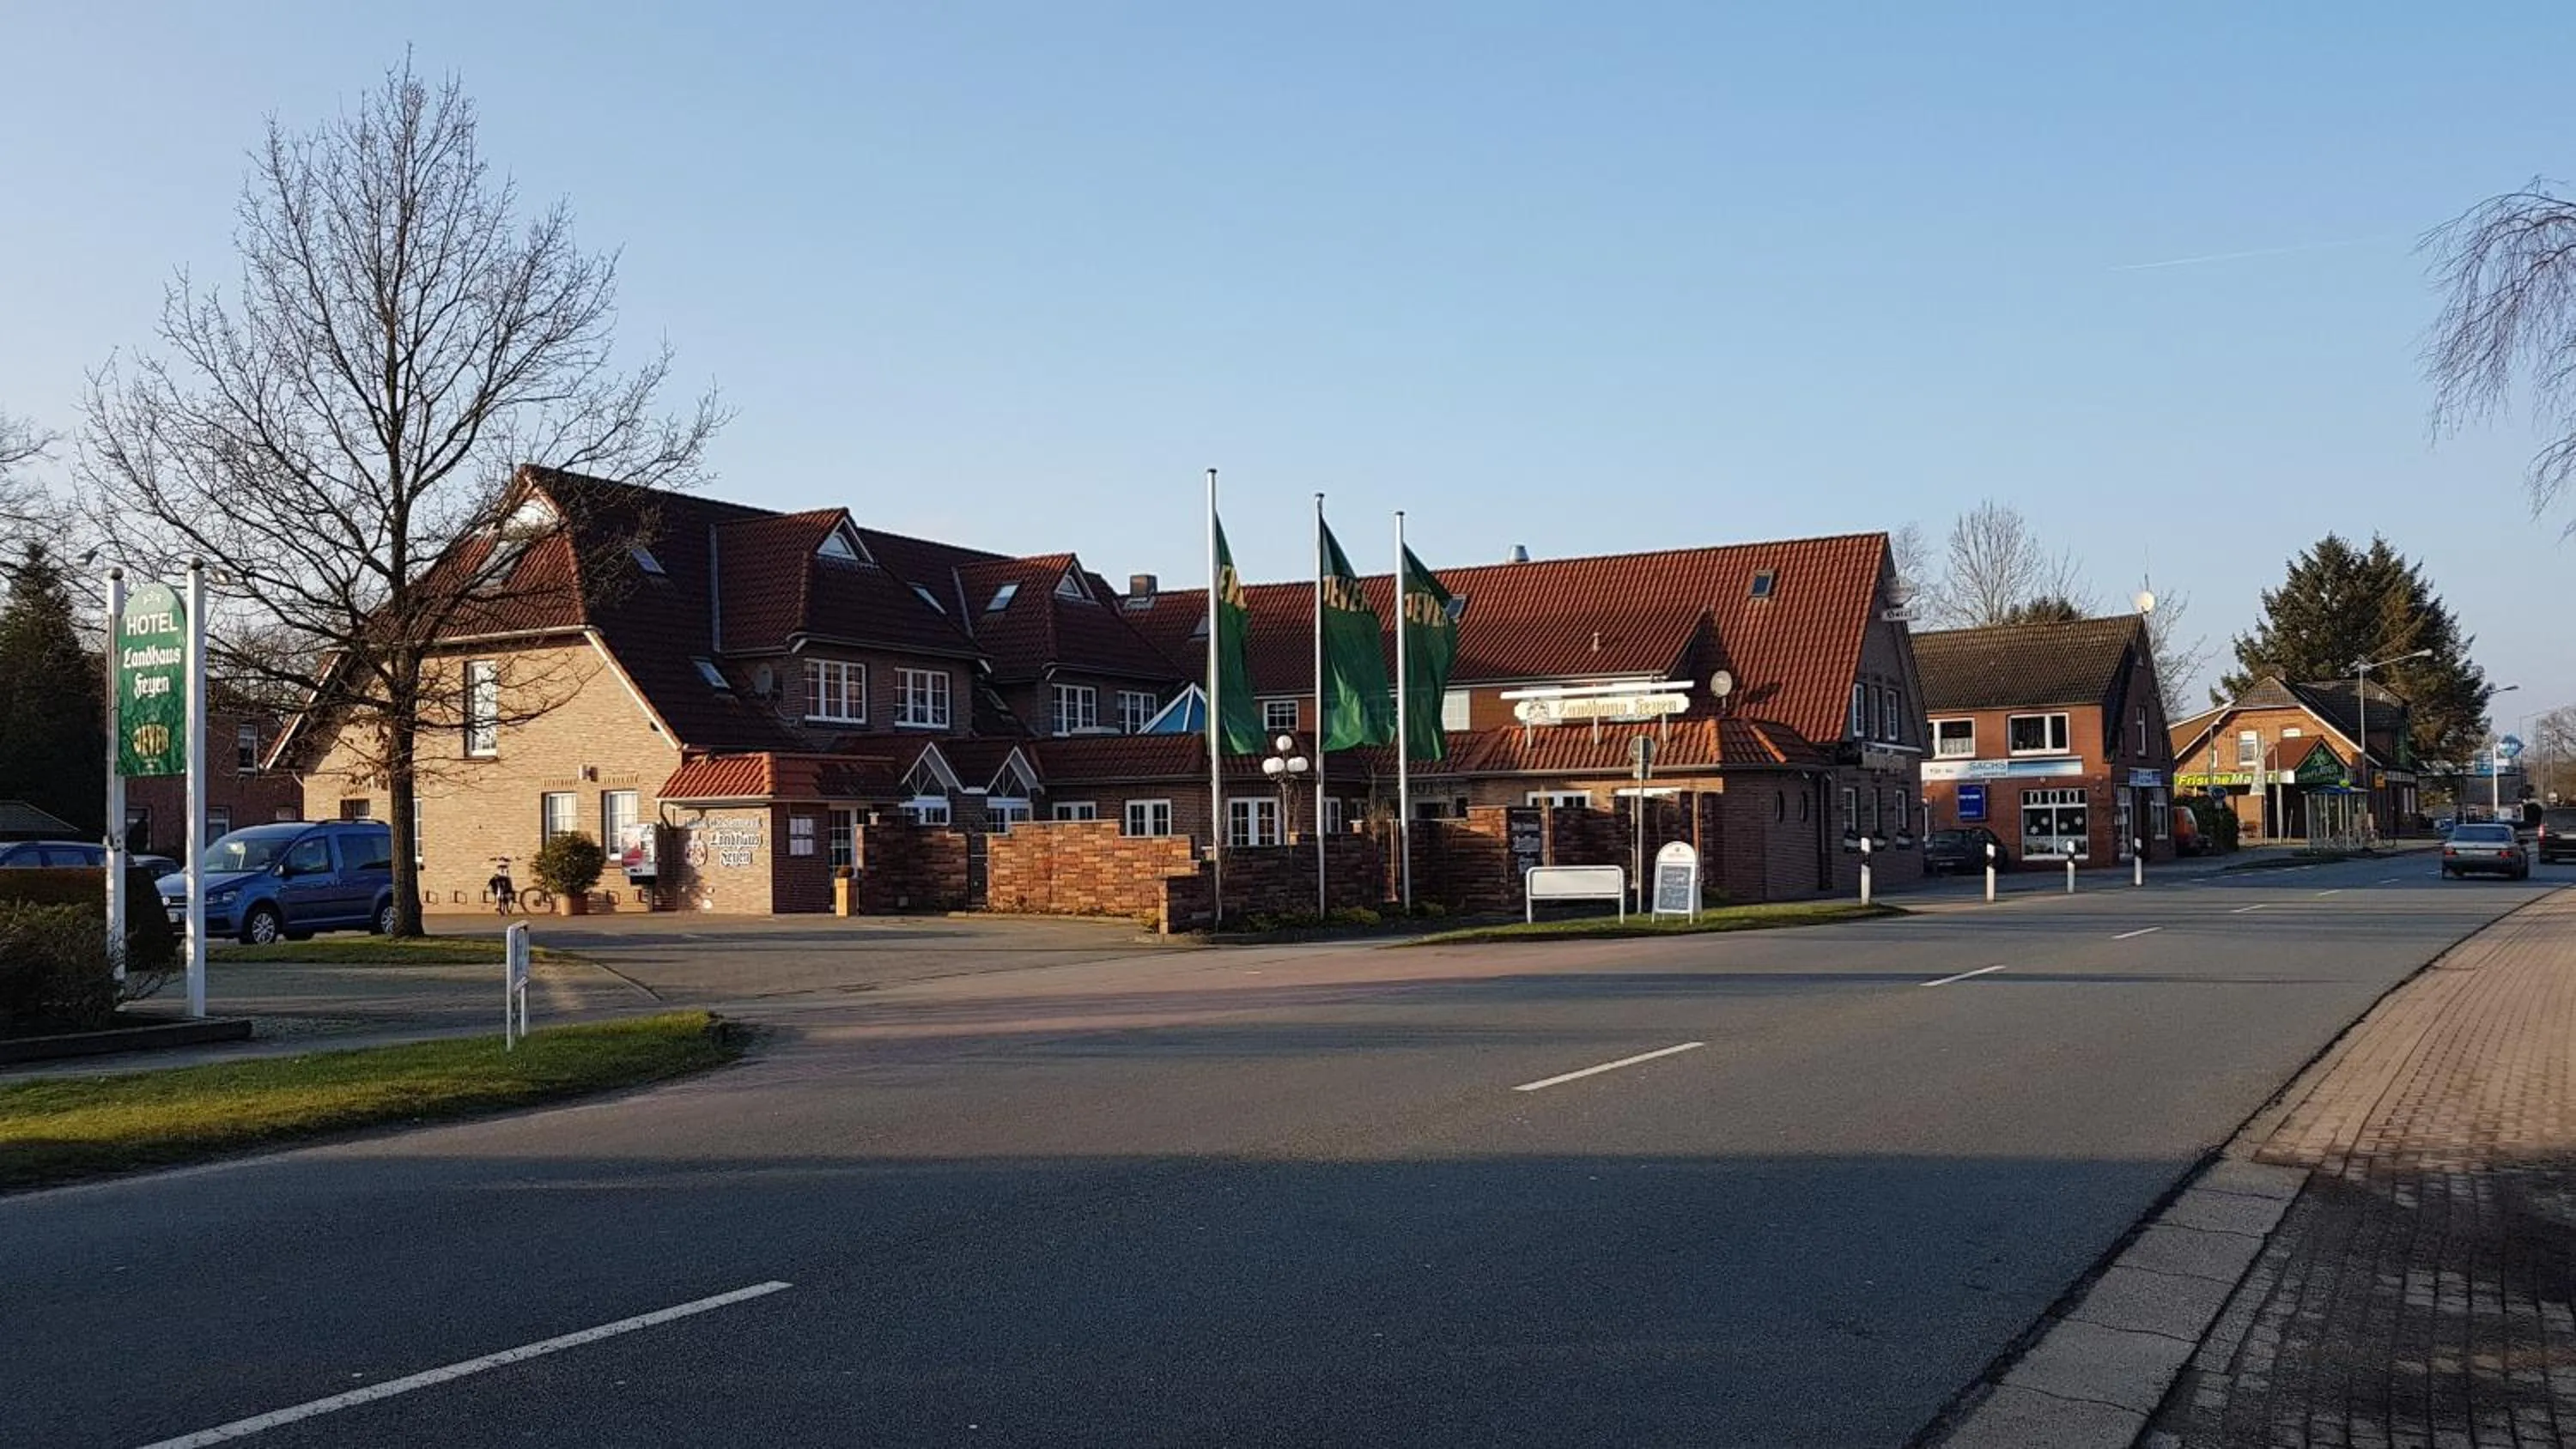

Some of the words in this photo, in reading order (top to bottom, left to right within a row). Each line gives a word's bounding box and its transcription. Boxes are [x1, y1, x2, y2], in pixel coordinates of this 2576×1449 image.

[126, 611, 179, 636] HOTEL
[123, 646, 181, 670] Landhaus
[134, 673, 170, 699] Feyen
[1558, 699, 1627, 716] Landhaus
[710, 830, 761, 850] Landhaus
